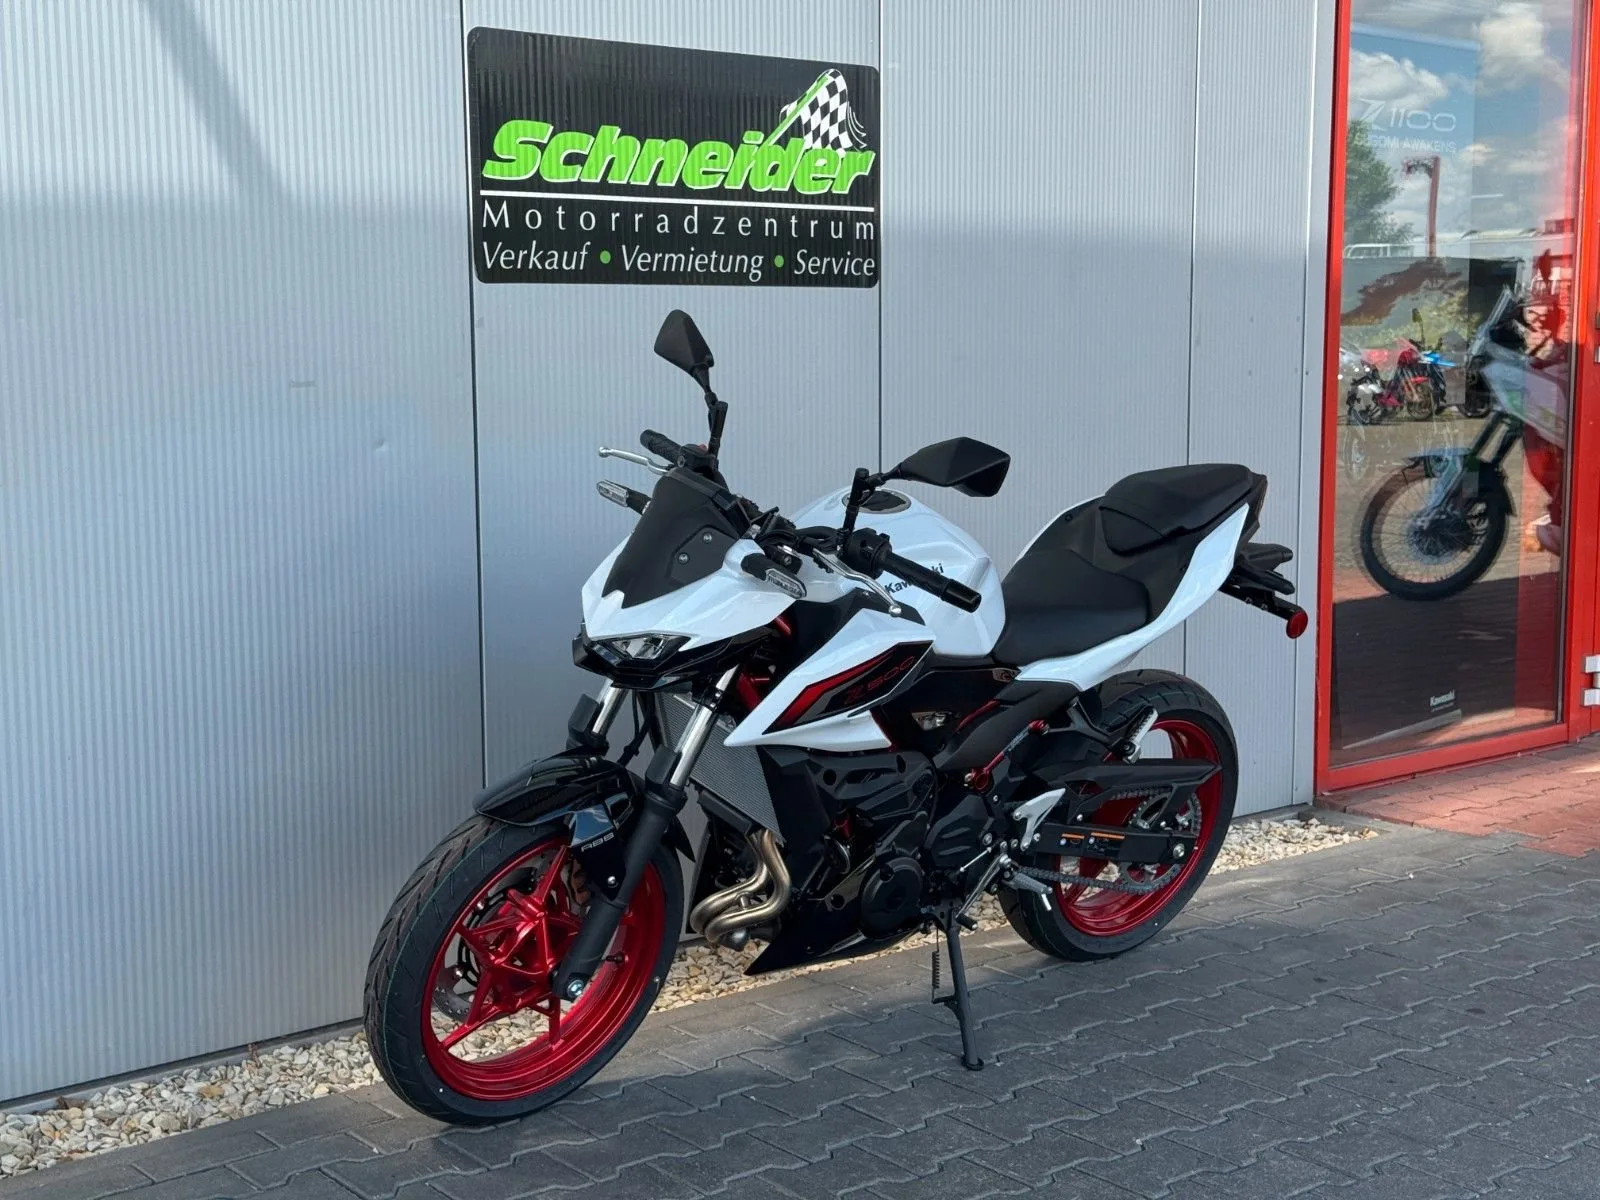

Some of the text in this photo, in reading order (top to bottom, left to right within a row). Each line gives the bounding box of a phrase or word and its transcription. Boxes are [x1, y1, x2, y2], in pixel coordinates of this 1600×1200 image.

[482, 119, 876, 194] Schneider
[482, 200, 874, 240] Motorradzentrum
[482, 241, 875, 282] Verkauf Vermietung Service
